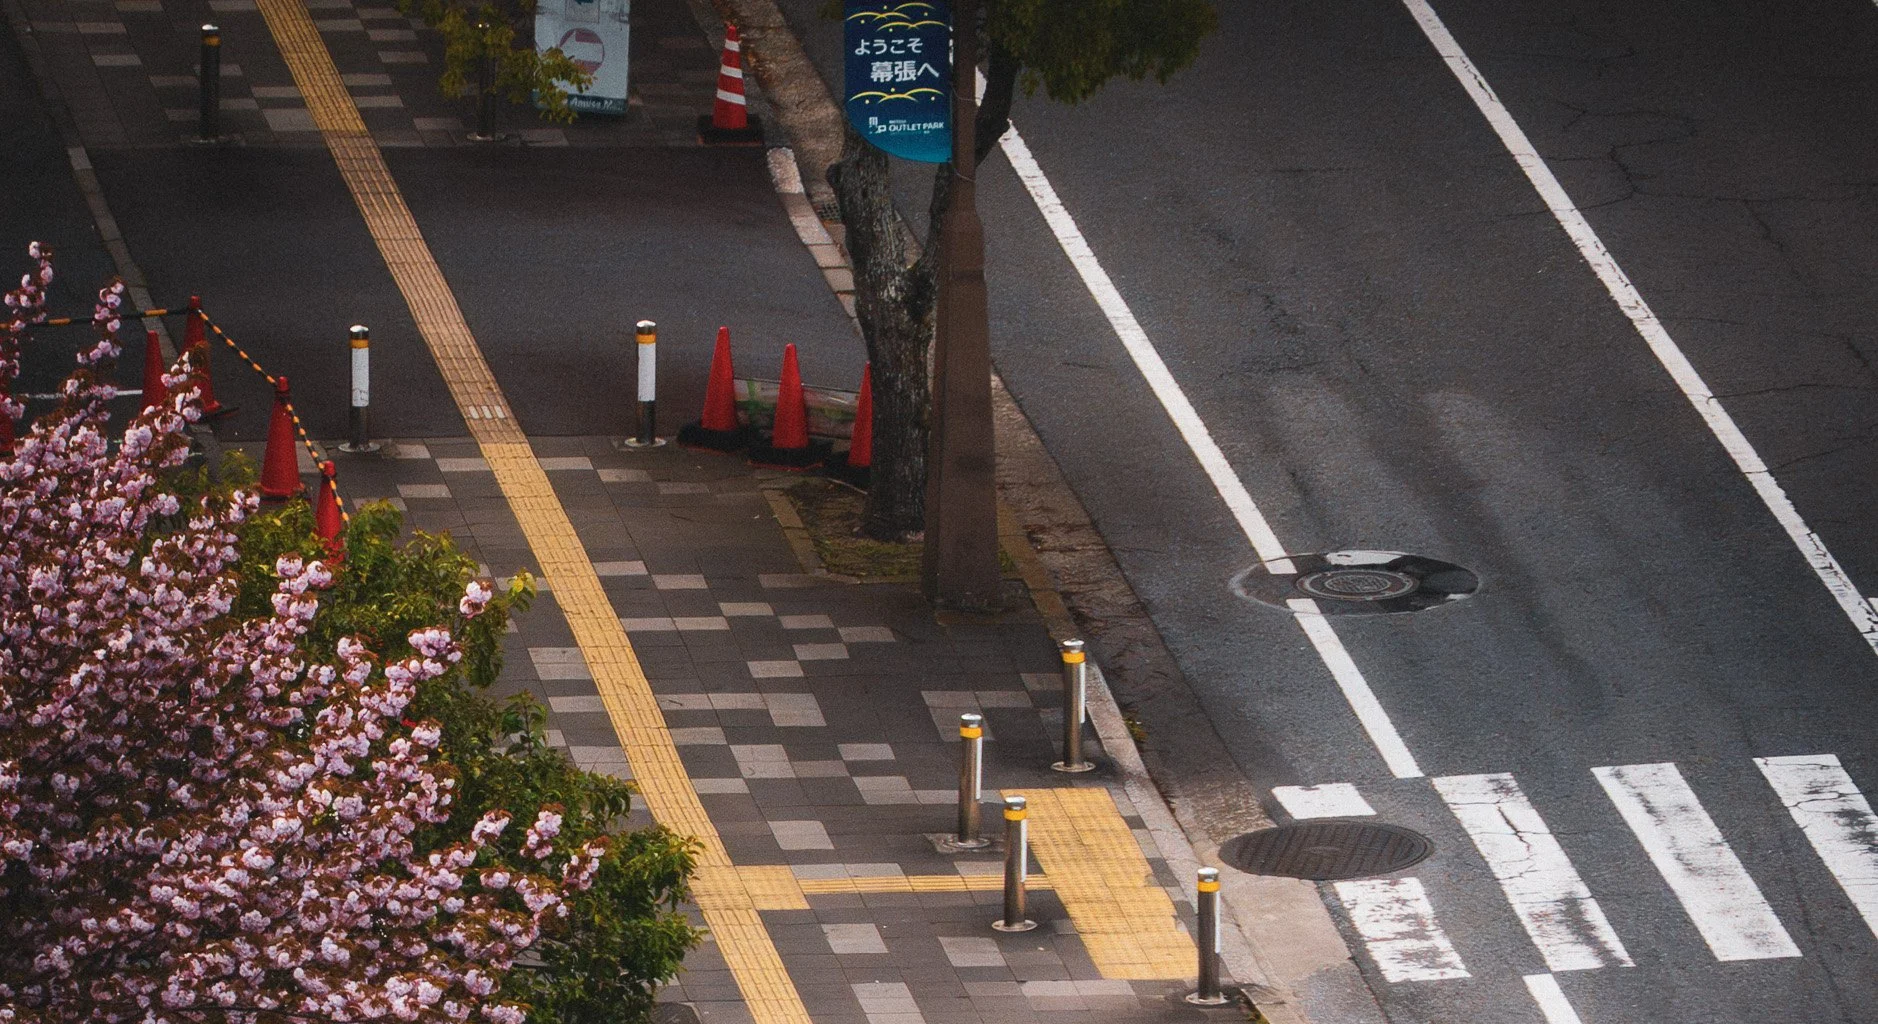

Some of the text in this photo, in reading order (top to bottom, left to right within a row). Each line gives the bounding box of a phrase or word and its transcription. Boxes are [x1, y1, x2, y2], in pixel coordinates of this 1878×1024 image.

[855, 38, 923, 55] ようこそ
[870, 60, 940, 82] 幕張へ
[888, 122, 921, 132] OUTLET
[922, 121, 944, 130] PARK
